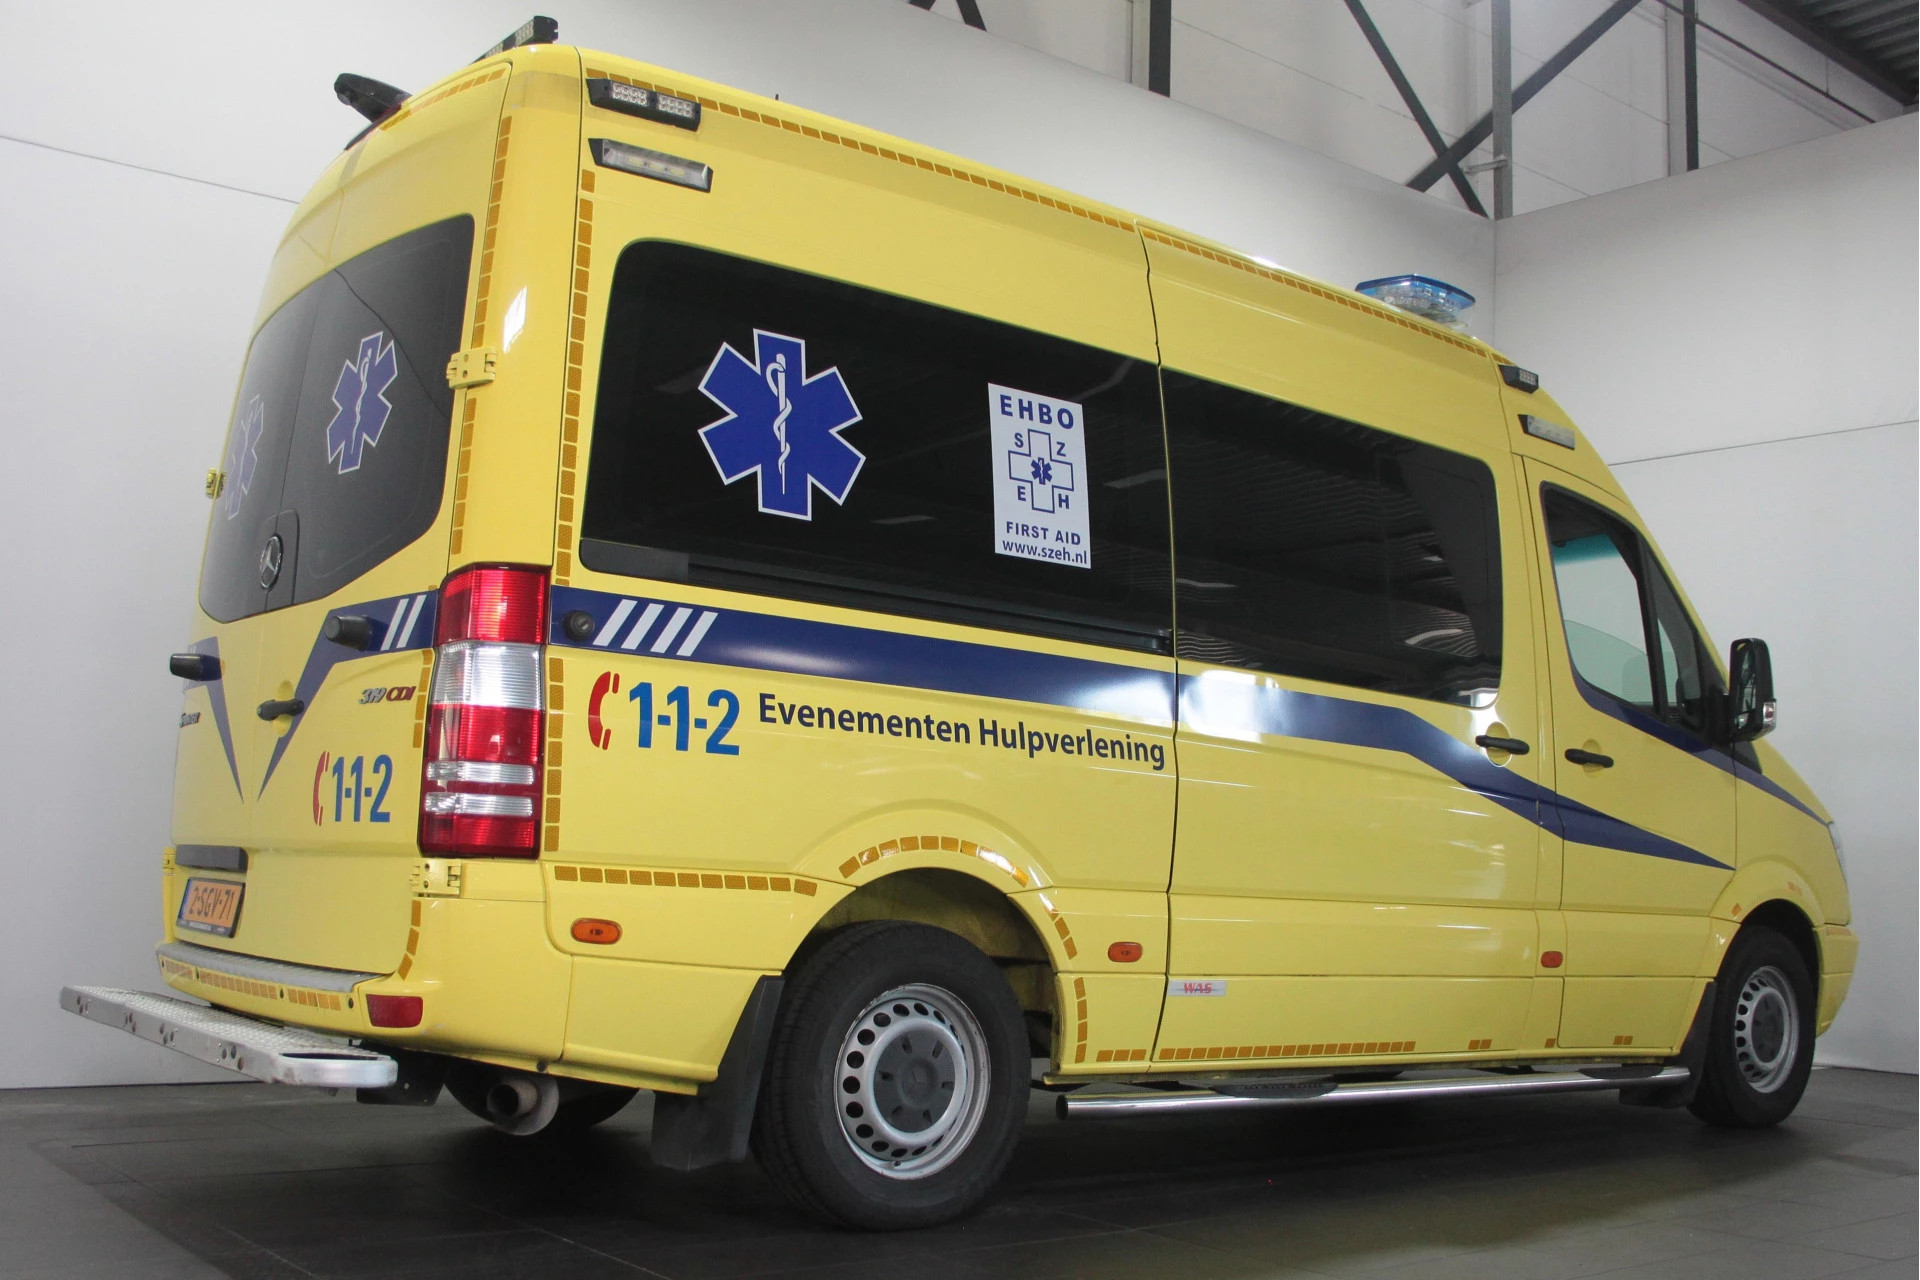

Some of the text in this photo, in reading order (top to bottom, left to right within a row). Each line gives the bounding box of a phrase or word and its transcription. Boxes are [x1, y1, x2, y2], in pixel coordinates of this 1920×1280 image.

[1000, 394, 1074, 430] EHBO
[1014, 432, 1066, 457] S Z
[1017, 486, 1070, 509] E H
[1006, 521, 1080, 546] FIRST AID
[1002, 540, 1087, 564] www.szeh.nl
[629, 681, 740, 756] 1-1-2
[759, 692, 1165, 770] Evenementen Hulpverlening
[332, 754, 393, 822] 1-1-2
